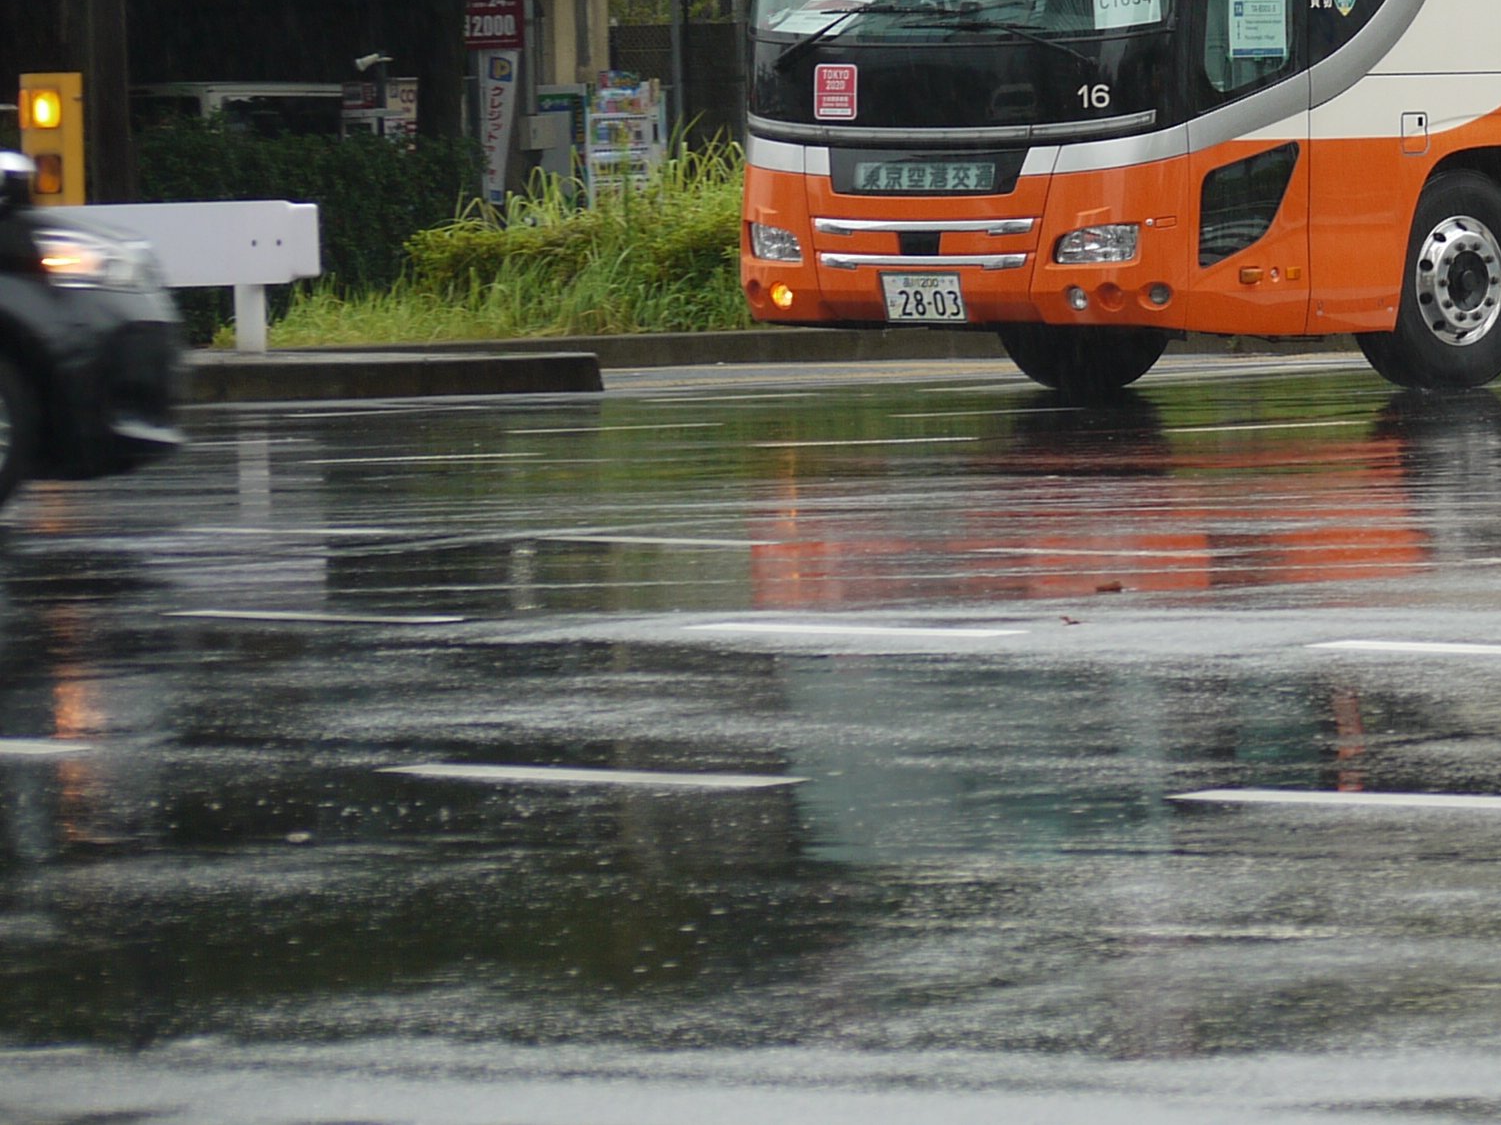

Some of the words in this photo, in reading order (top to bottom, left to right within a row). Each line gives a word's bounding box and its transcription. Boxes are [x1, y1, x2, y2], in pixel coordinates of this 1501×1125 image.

[822, 68, 850, 80] TOKYO
[1077, 84, 1110, 109] 16
[861, 163, 994, 189] 東京空港交通
[898, 290, 961, 317] 28-03
